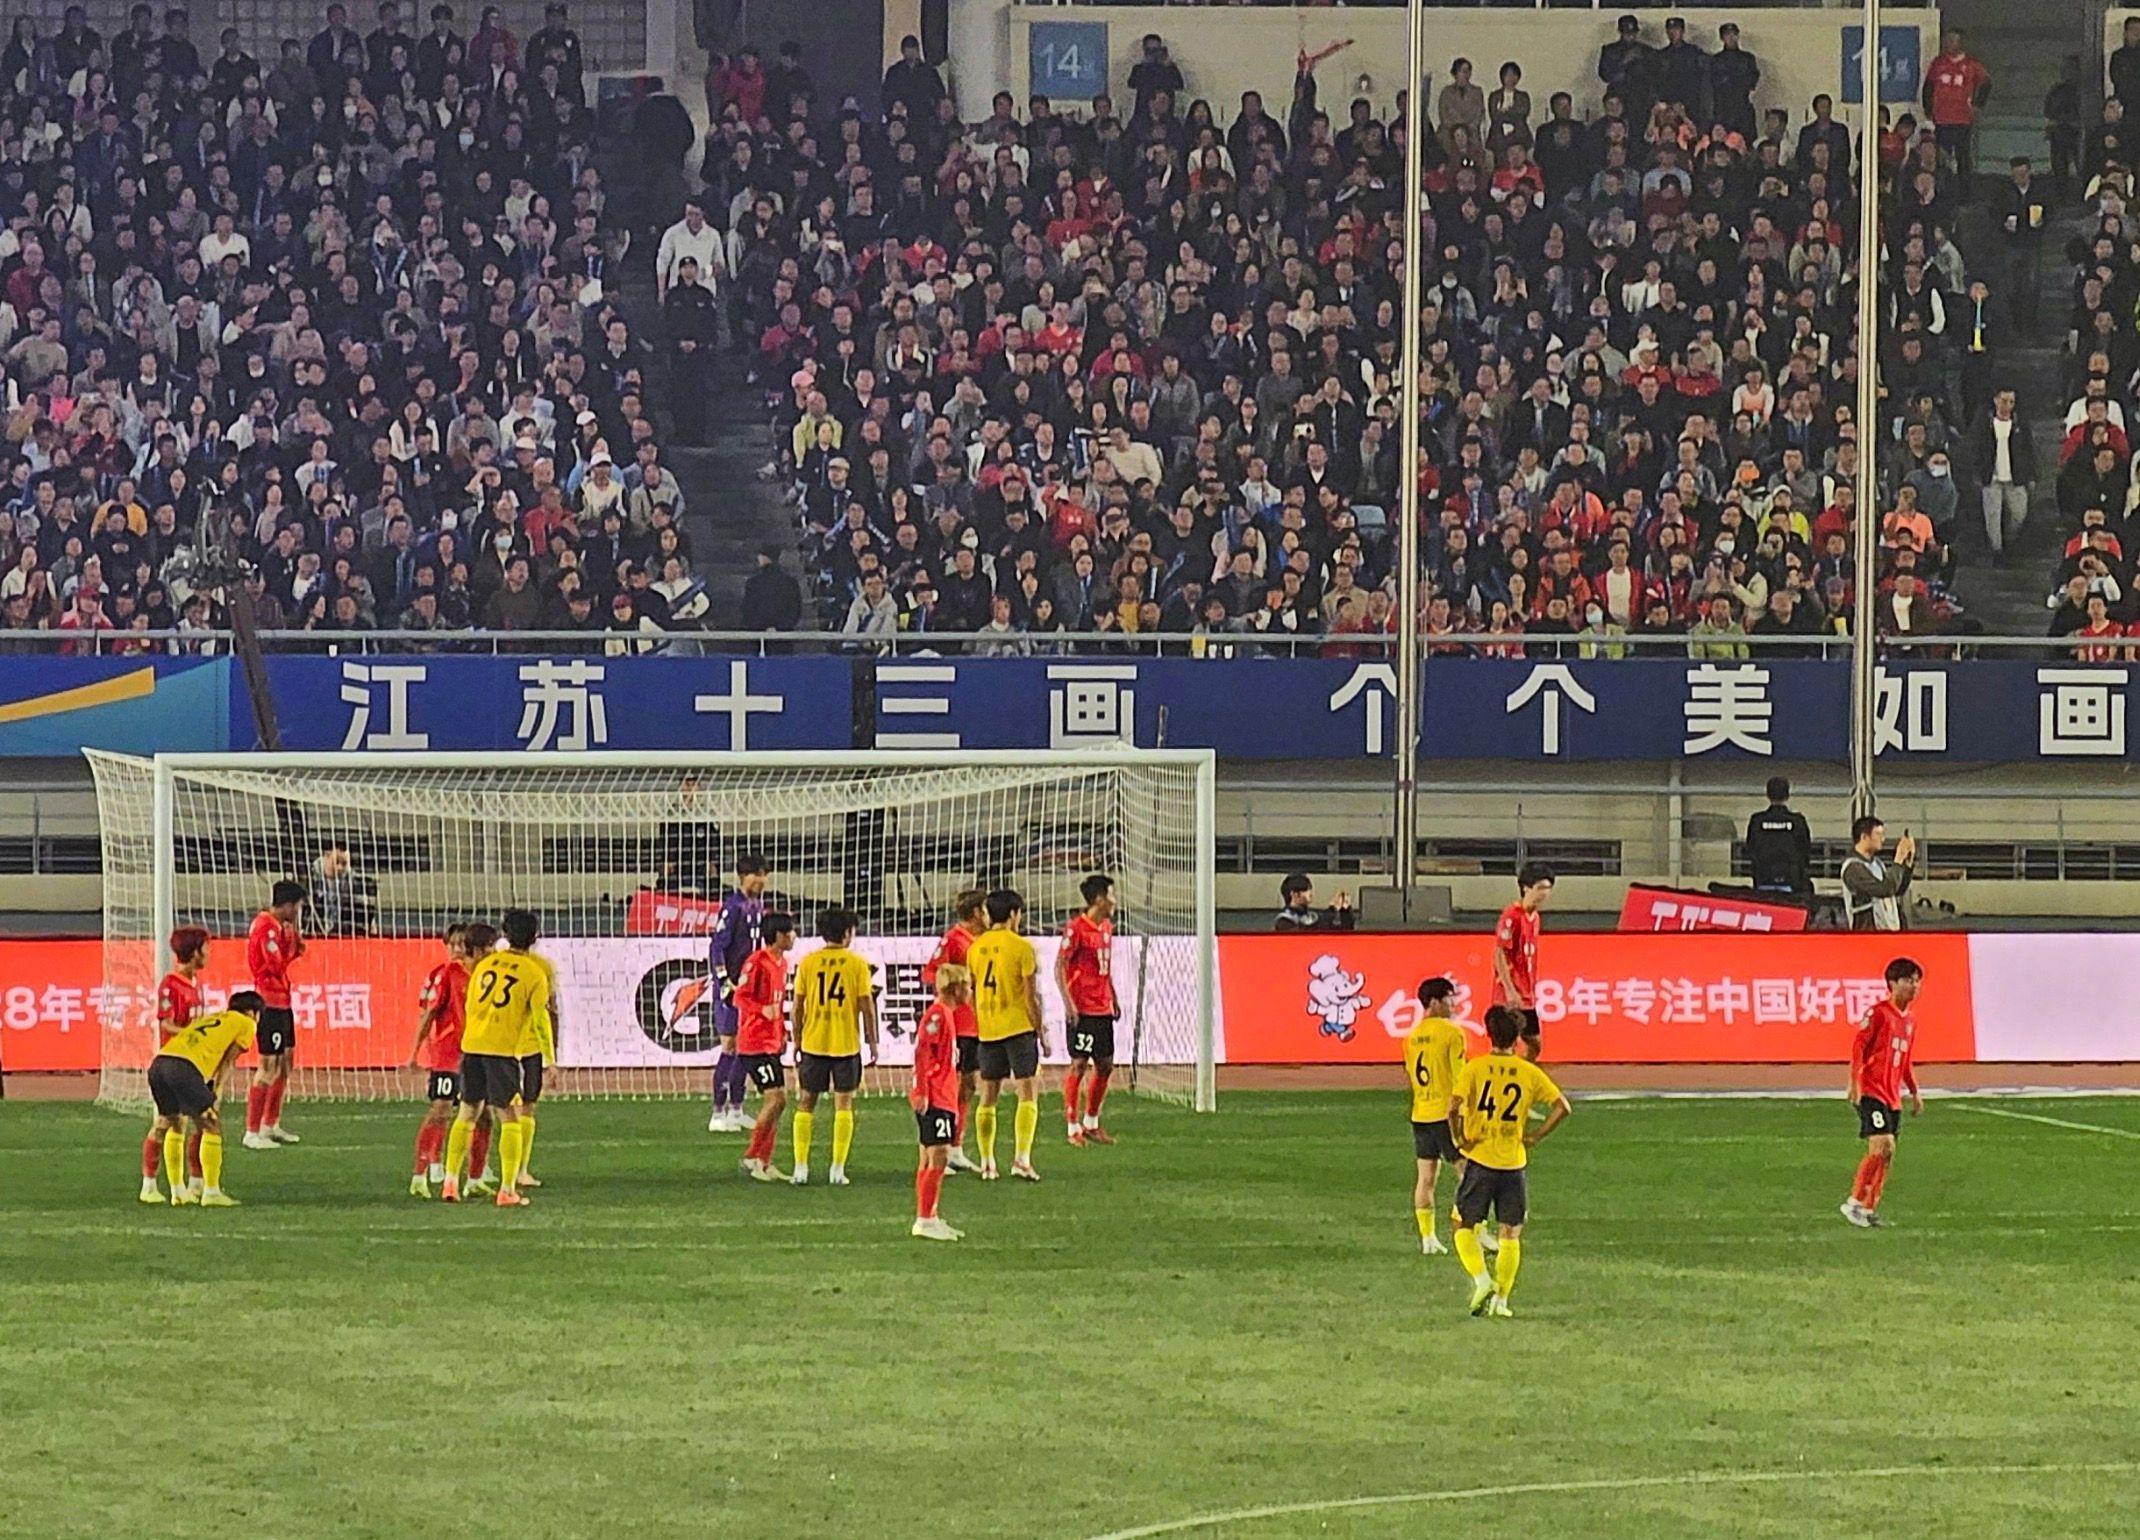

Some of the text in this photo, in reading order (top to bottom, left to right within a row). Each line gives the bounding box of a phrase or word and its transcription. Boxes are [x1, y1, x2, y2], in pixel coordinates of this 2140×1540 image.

[341, 660, 2129, 756] 江苏十三画 个个美如画
[478, 969, 520, 1009] 93
[817, 971, 846, 1008] 14
[983, 959, 997, 996] 4
[272, 1031, 282, 1050] 9
[1075, 1033, 1093, 1052] 32
[436, 1076, 452, 1096] 10
[757, 1063, 775, 1084] 31
[1415, 1050, 1430, 1087] 6
[1477, 1080, 1522, 1122] 42
[1872, 1110, 1885, 1129] 8
